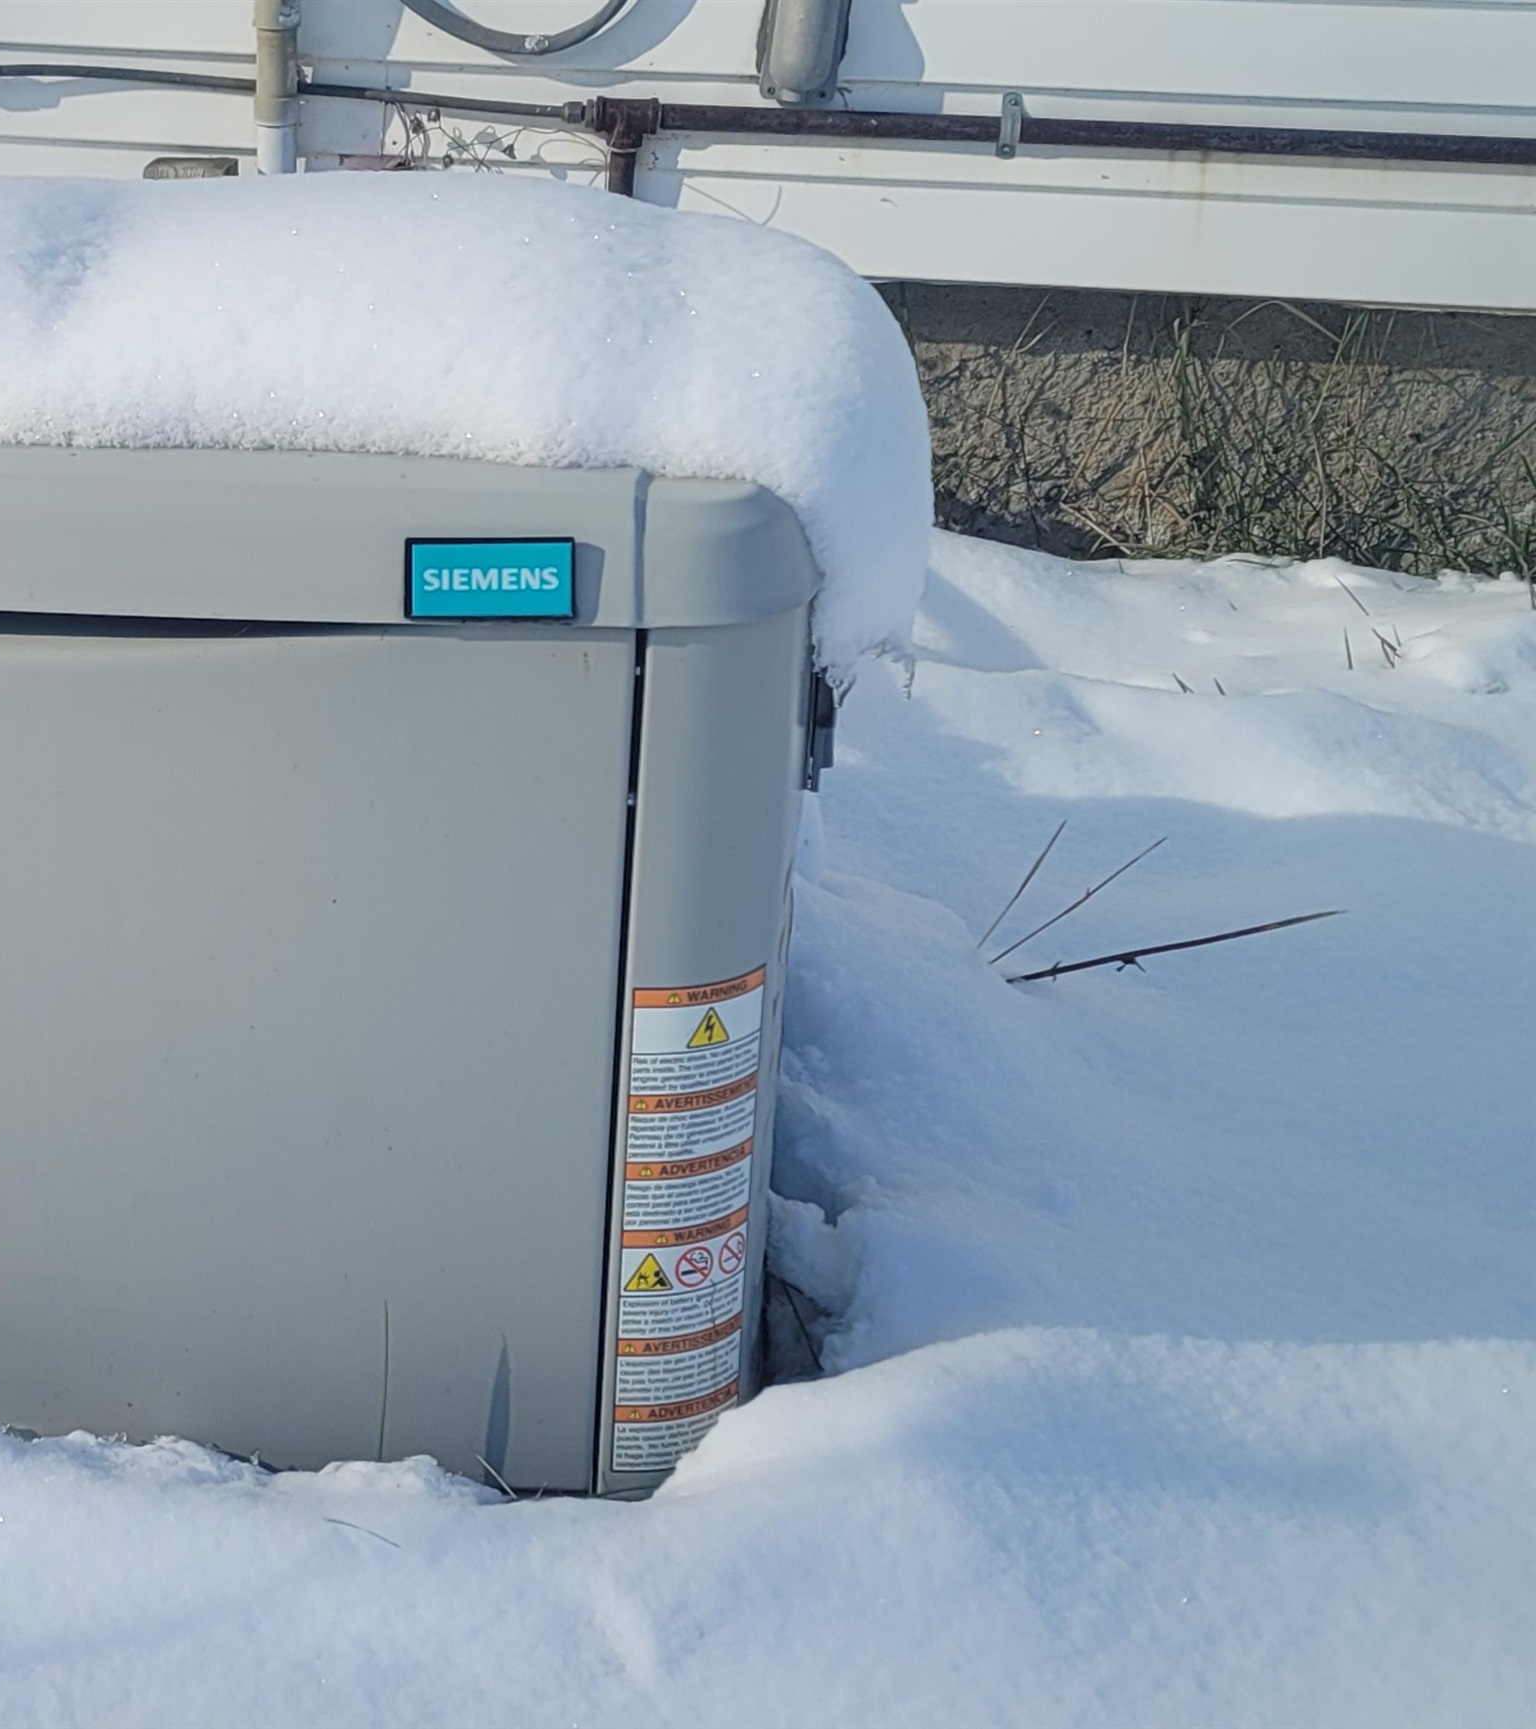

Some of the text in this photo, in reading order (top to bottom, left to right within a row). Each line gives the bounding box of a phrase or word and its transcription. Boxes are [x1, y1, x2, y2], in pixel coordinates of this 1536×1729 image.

[423, 567, 559, 590] SIEMENS
[687, 980, 747, 1002] WARNING
[633, 1076, 658, 1084] engine
[660, 1074, 696, 1083] generator
[668, 1082, 677, 1090] by
[654, 1075, 755, 1109] AVERTISSEMENT
[660, 1146, 744, 1176] ADVERTENCIA
[674, 1218, 732, 1242] WARNING
[643, 1318, 741, 1352] AVERTISSEMENT
[648, 1388, 732, 1418] ADVERTENCIA
